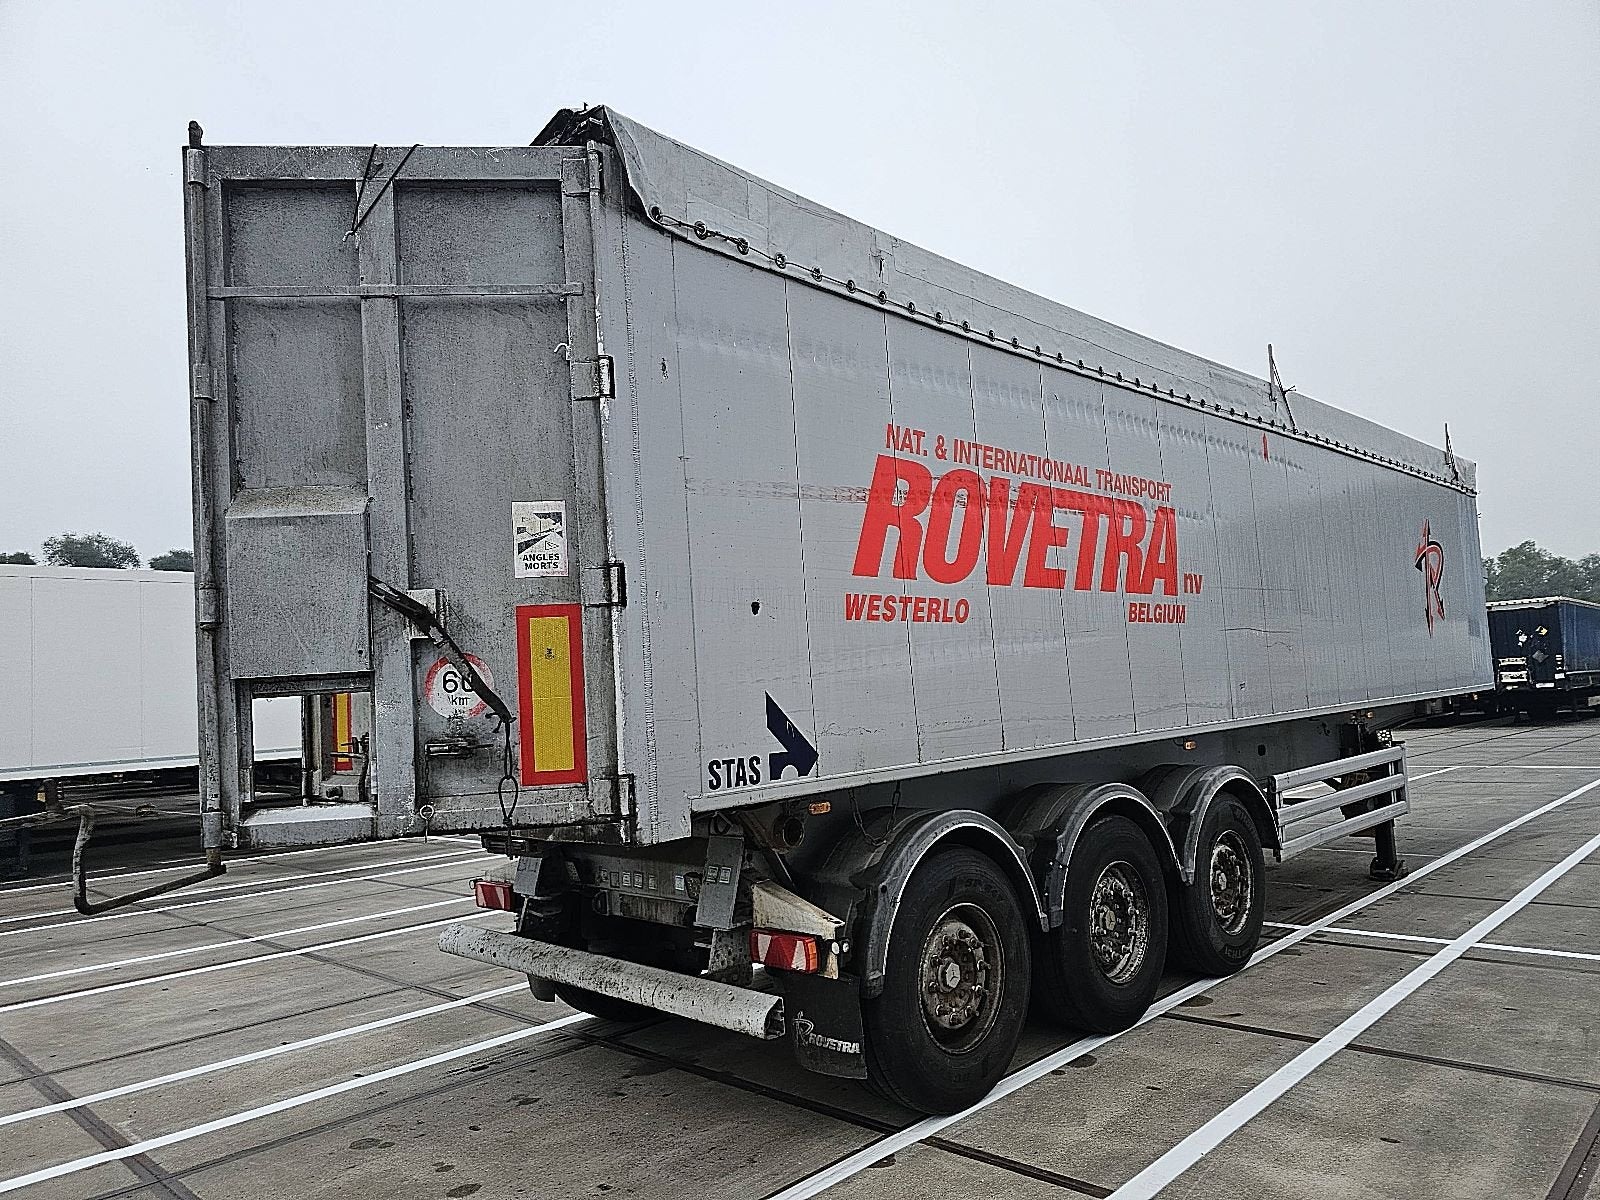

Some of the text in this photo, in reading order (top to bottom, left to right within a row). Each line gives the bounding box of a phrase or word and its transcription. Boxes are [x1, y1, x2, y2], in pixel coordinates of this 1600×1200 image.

[886, 423, 1172, 503] NAT. & INTERNATIONAAL TRANSPORT
[852, 454, 1203, 597] ROVETRA nv
[522, 553, 560, 562] ANGLES
[524, 561, 559, 571] MORTS
[845, 593, 1187, 624] WESTERLO BELGIUM
[451, 695, 470, 706] km
[707, 755, 761, 790] STAS
[808, 1032, 861, 1054] ROVETRA
